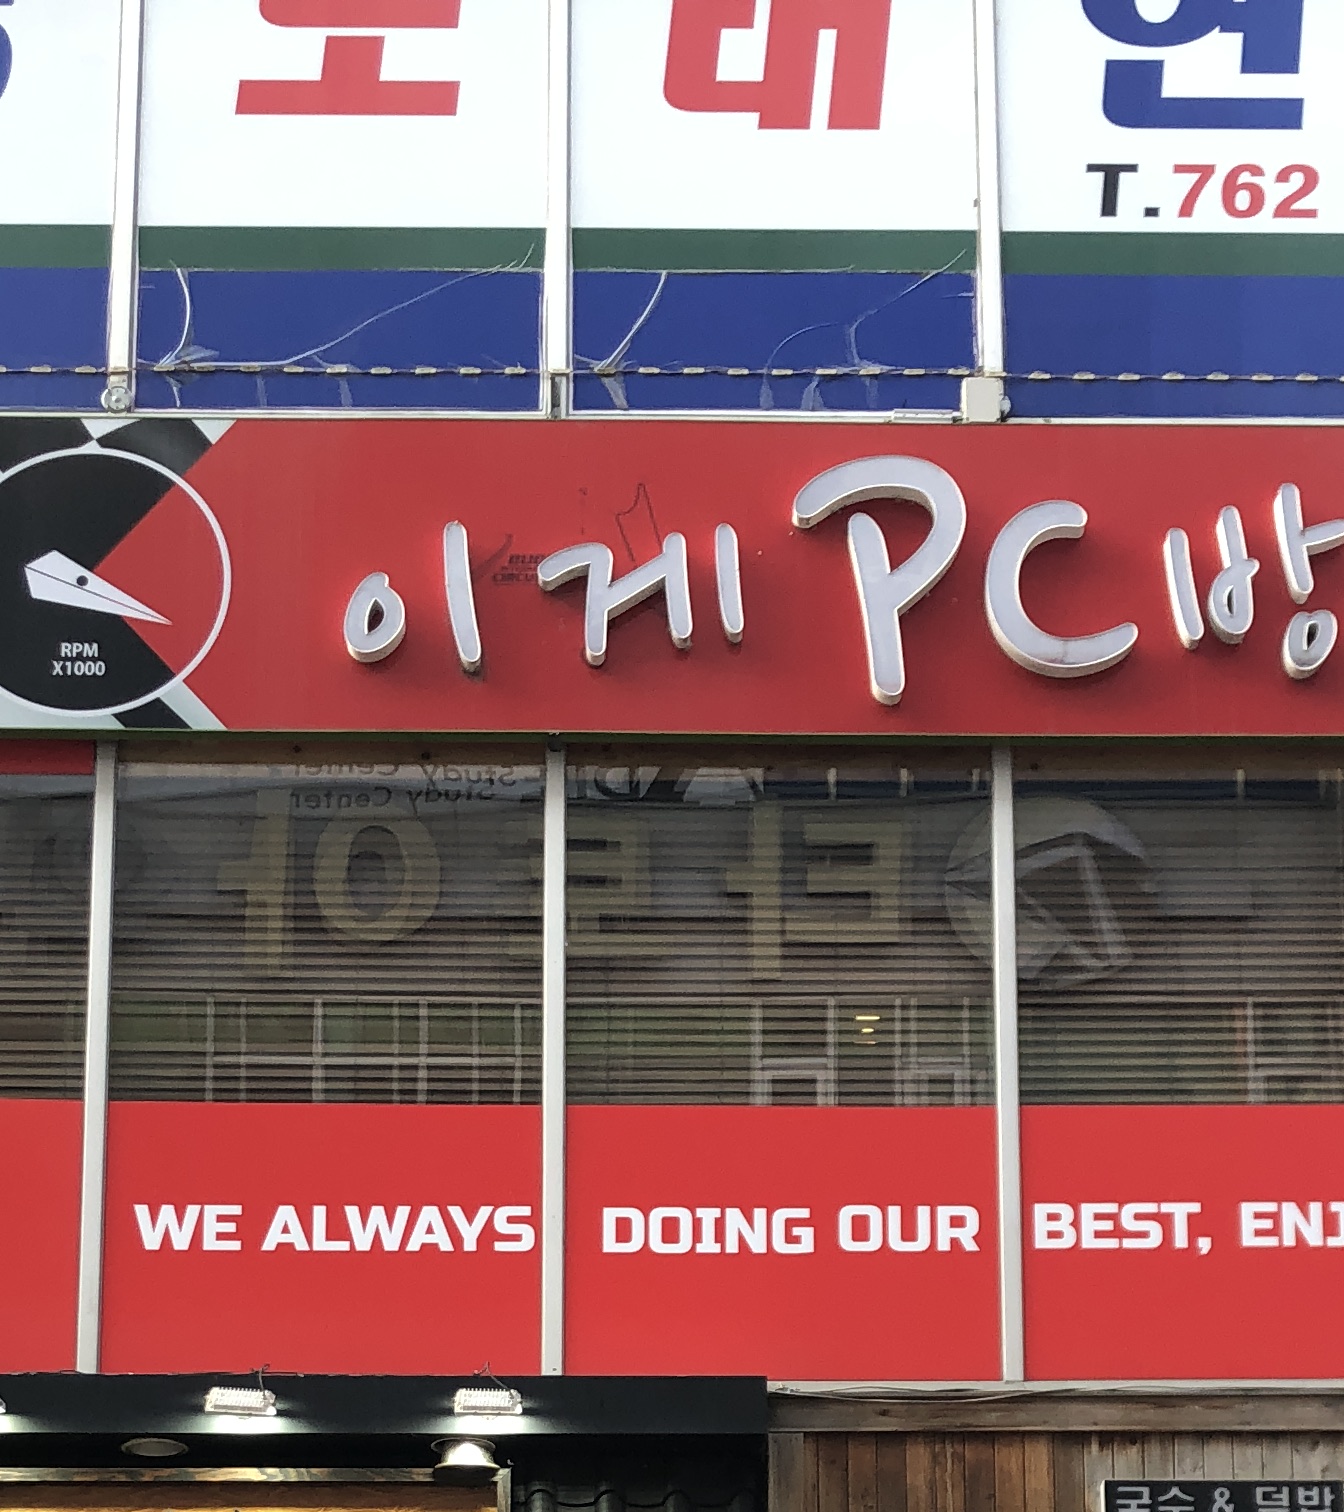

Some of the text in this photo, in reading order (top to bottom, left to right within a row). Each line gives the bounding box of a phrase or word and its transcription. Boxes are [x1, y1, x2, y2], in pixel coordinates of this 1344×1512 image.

[343, 521, 745, 674] 이게
[60, 642, 99, 659] RPM
[52, 660, 106, 678] X1000
[133, 1203, 243, 1253] WE
[260, 1204, 536, 1253] ALWAYS
[602, 1206, 816, 1255] DOING
[837, 1204, 981, 1253] OUR
[1033, 1201, 1213, 1256] BEST,
